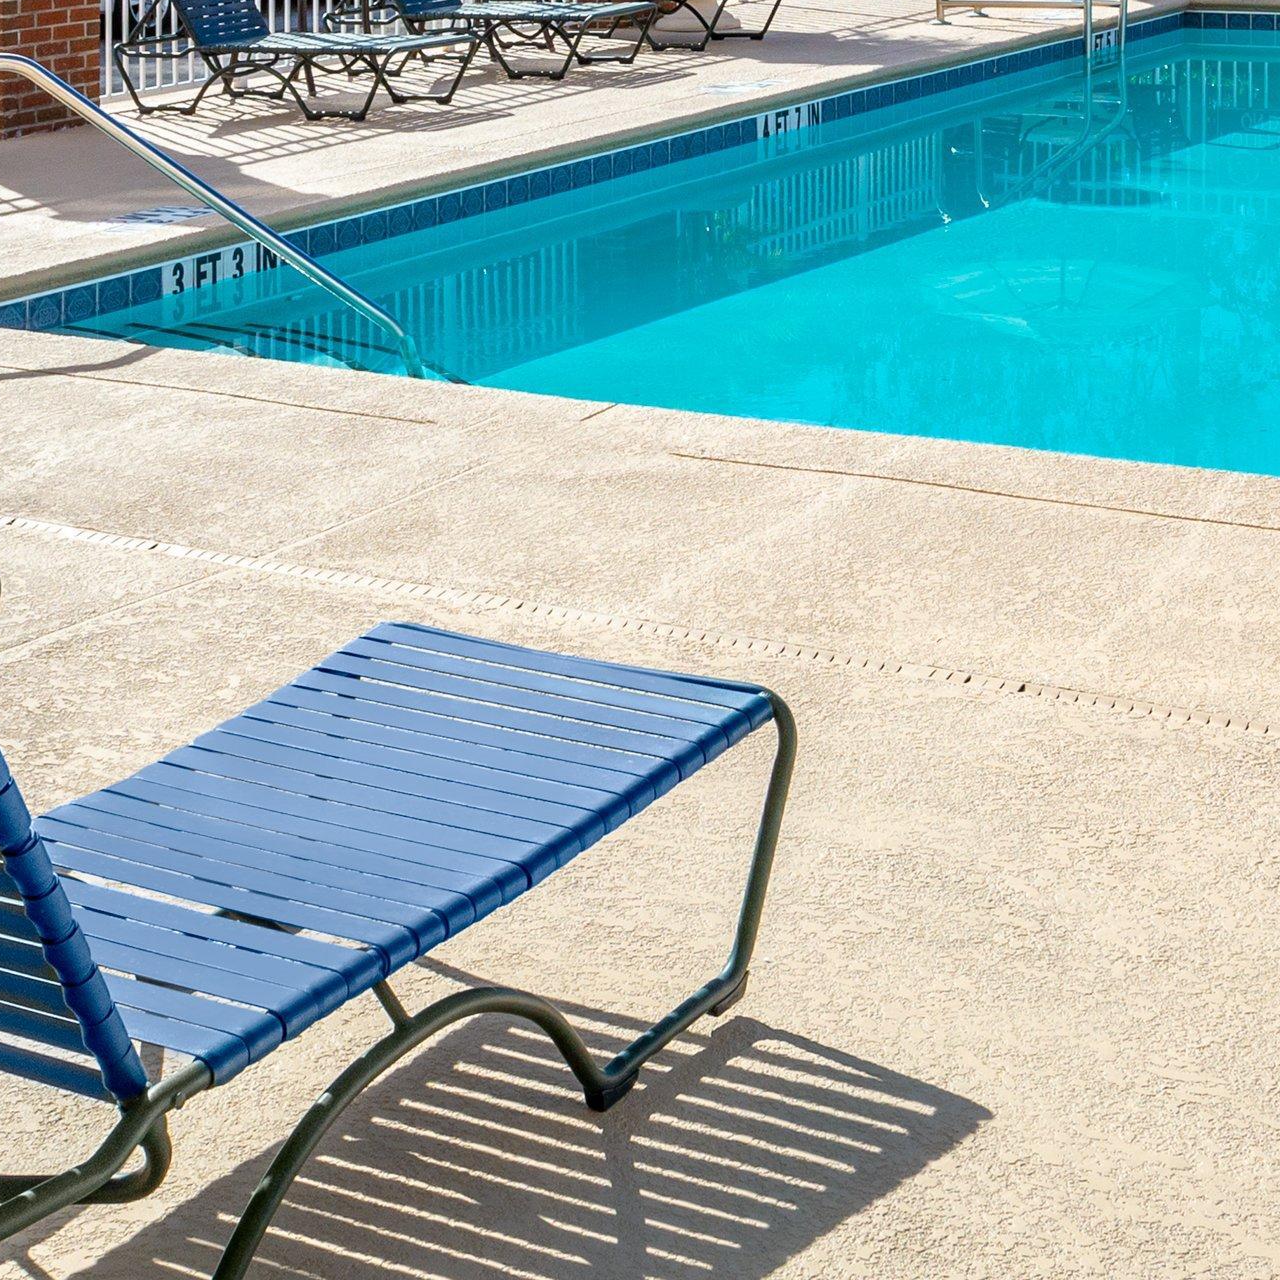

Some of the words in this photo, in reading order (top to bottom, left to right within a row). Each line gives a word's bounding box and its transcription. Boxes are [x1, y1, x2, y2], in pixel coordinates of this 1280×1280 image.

[1095, 34, 1104, 51] FT
[763, 114, 770, 138] 4
[775, 110, 789, 135] FT
[795, 107, 801, 130] 7
[807, 102, 820, 127] IN
[172, 262, 185, 295] 3
[196, 252, 222, 289] FT
[232, 247, 244, 279] 3
[256, 242, 278, 272] IN
